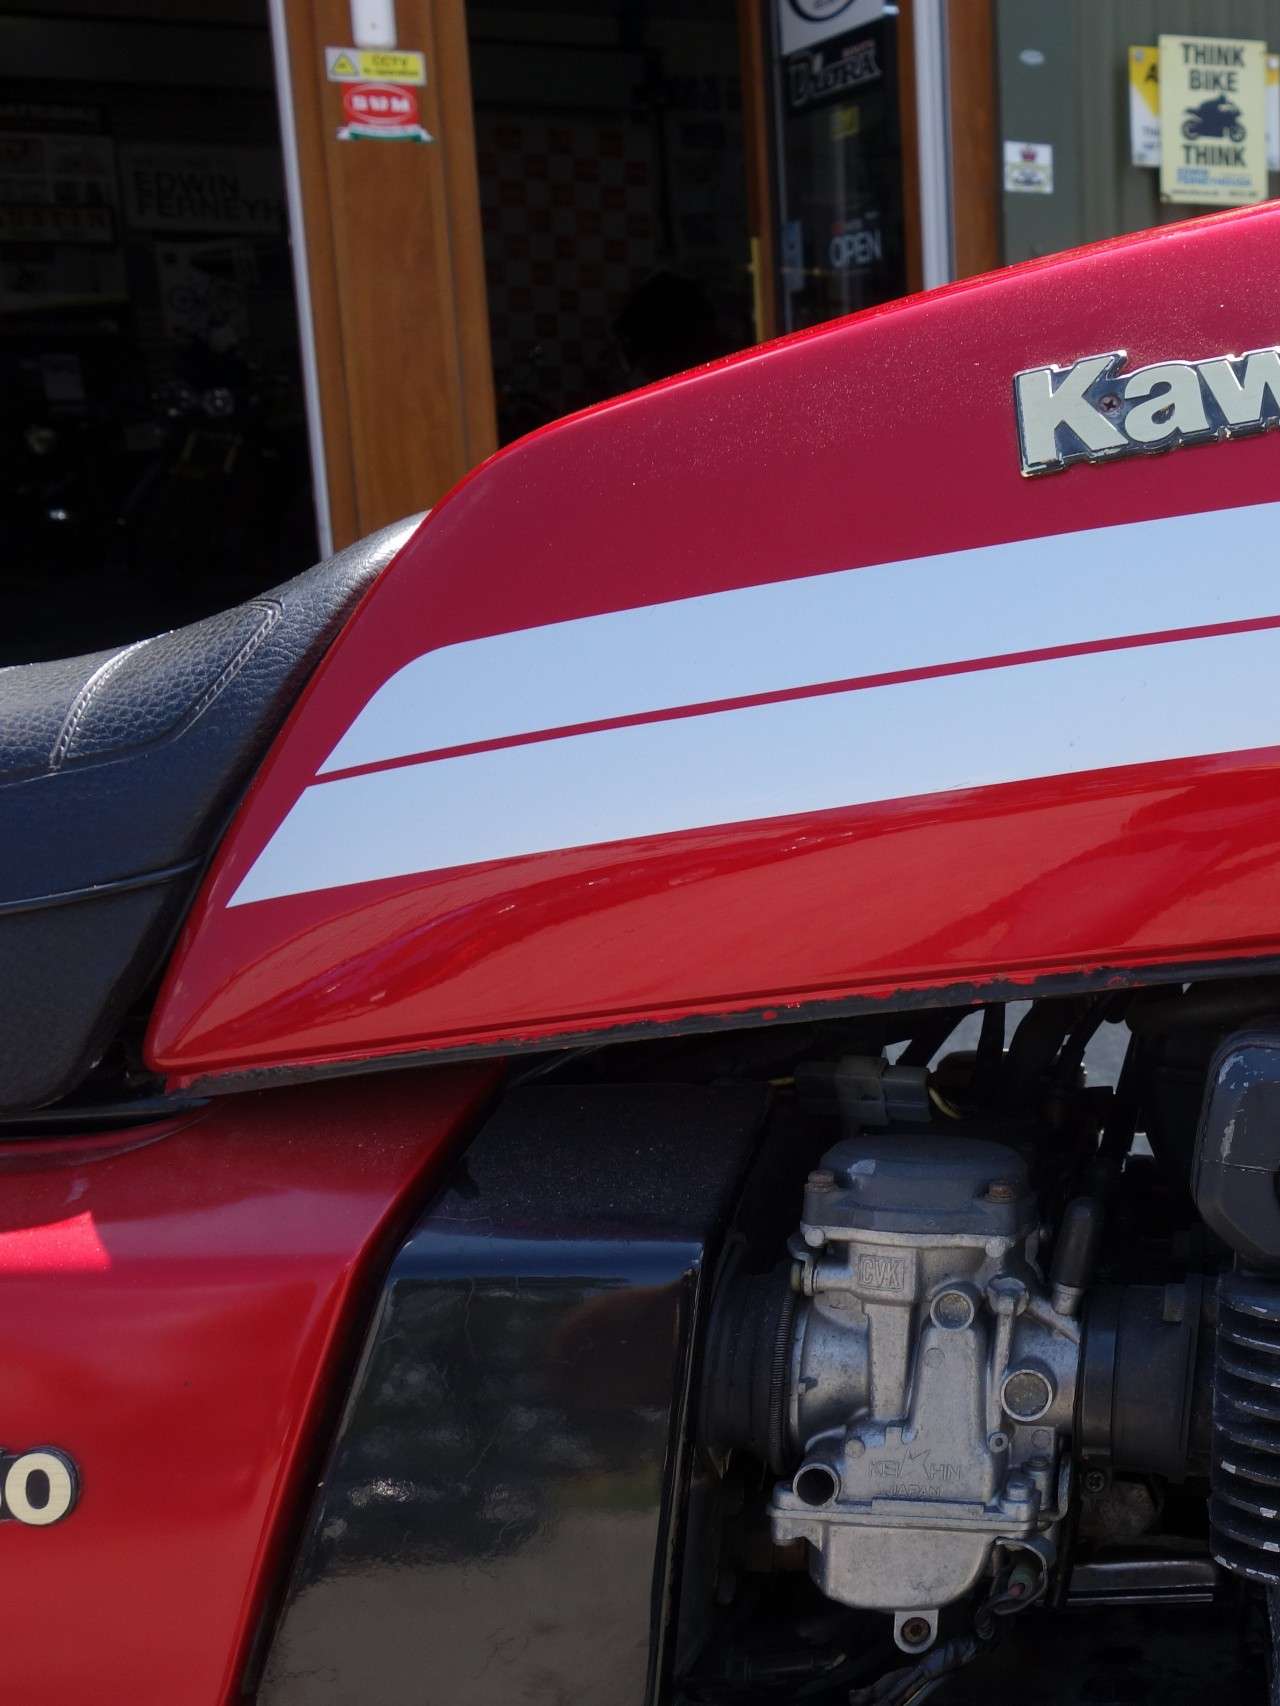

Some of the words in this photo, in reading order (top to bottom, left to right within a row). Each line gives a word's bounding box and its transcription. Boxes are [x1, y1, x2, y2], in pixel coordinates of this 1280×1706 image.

[372, 55, 408, 66] CCTV
[1181, 43, 1246, 67] THINK
[1188, 69, 1239, 91] BIKE
[1182, 145, 1247, 167] THINK
[133, 170, 240, 200] EDWIN
[829, 229, 883, 269] OPEN
[863, 1260, 901, 1289] CVK
[890, 1483, 944, 1498] JAPAN
